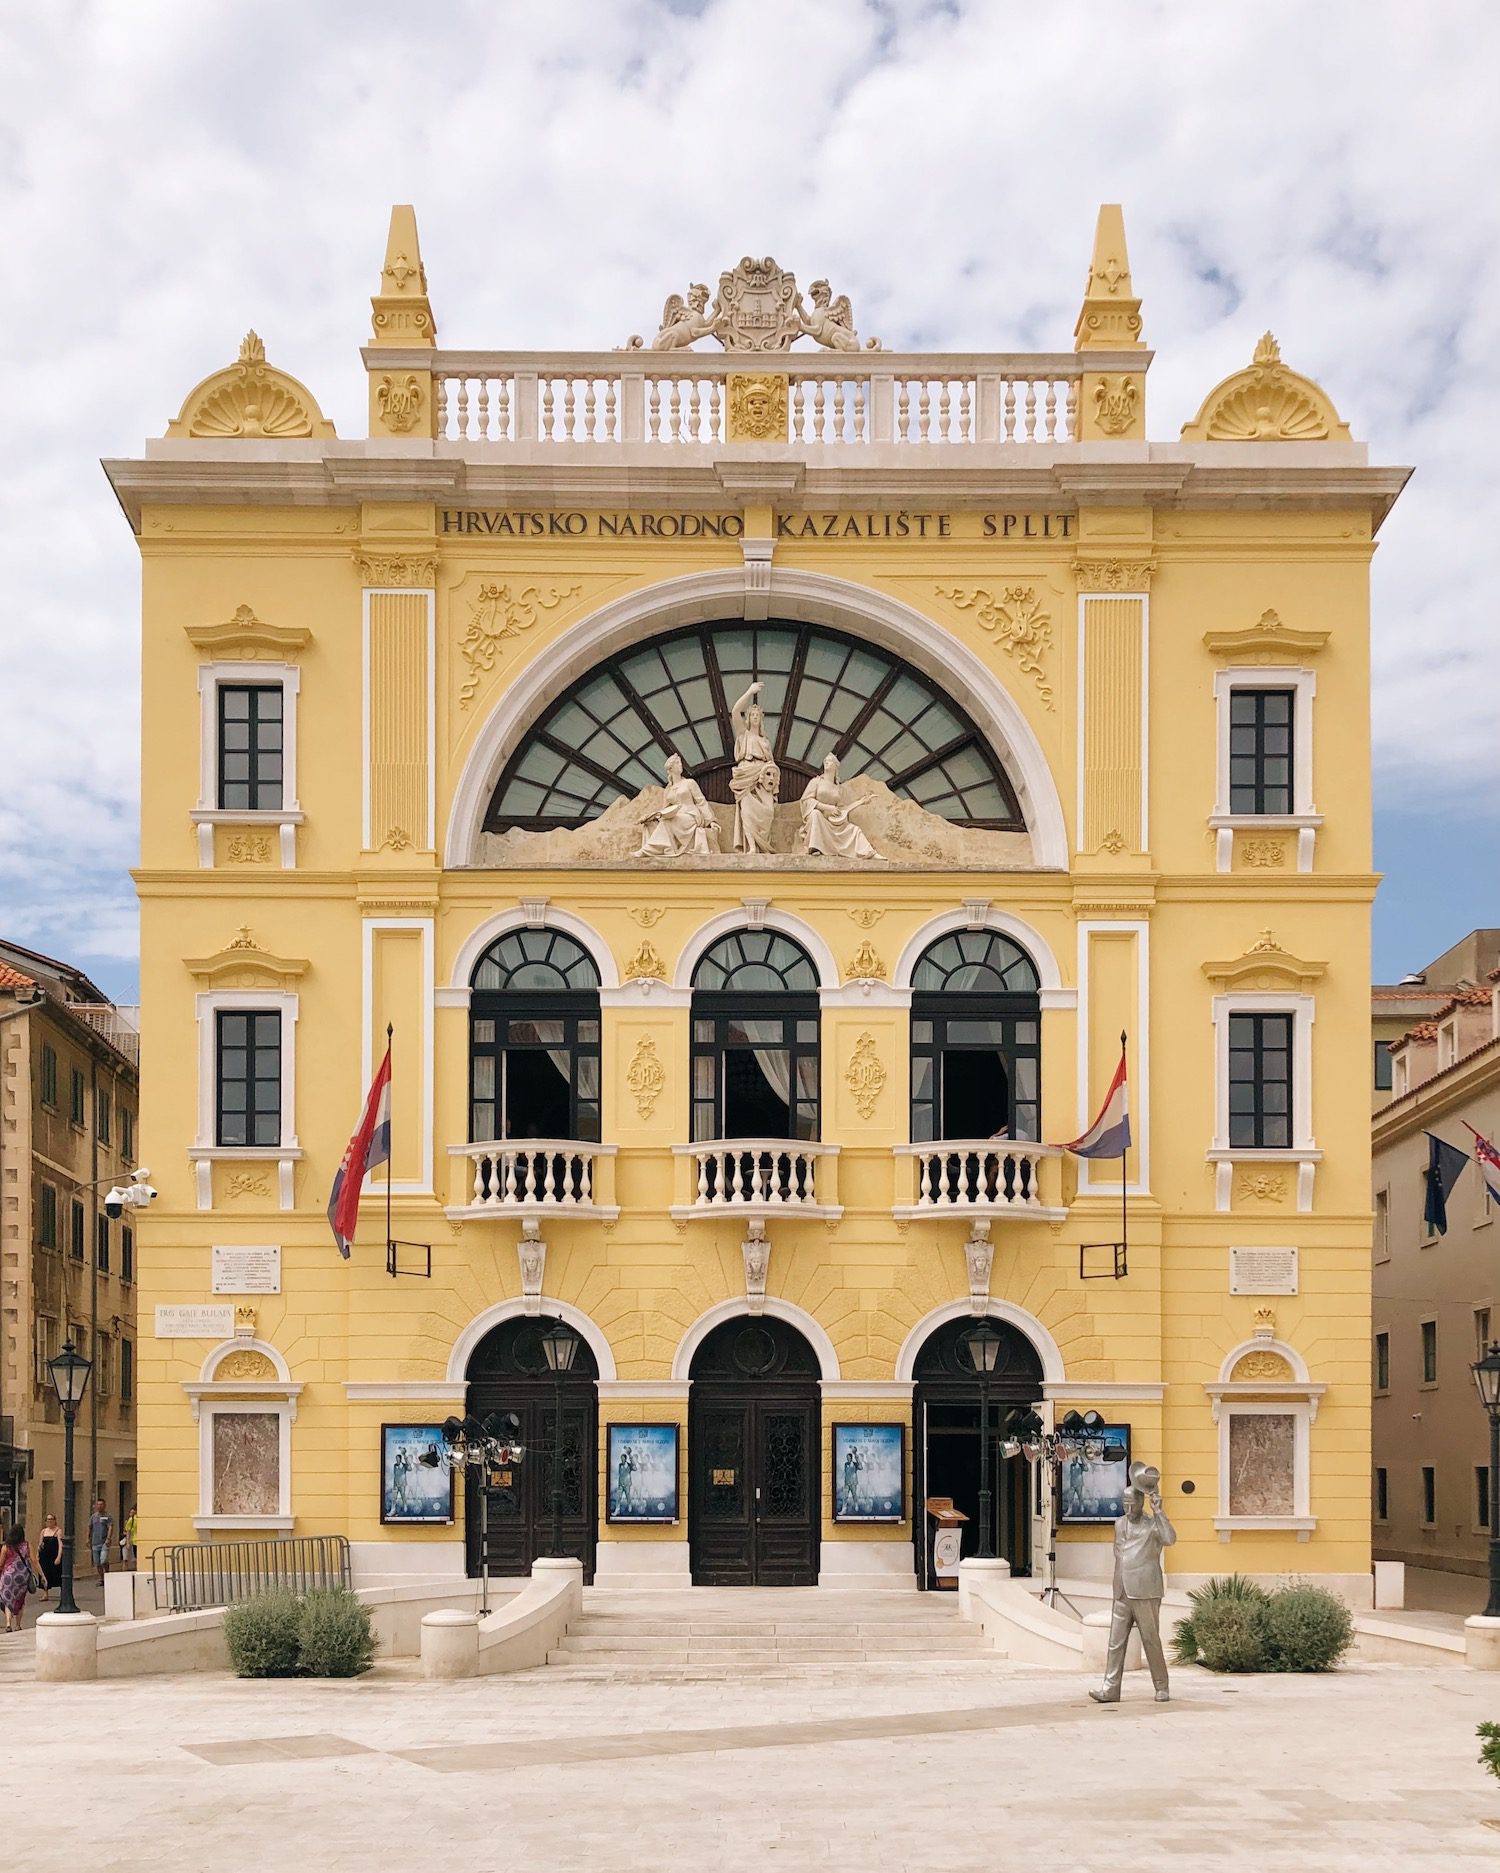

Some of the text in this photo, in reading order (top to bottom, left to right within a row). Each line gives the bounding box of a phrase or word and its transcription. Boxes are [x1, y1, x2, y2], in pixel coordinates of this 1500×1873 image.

[442, 510, 1076, 537] HRVATSKO NARODNO KAZALIŠTE SPLIT
